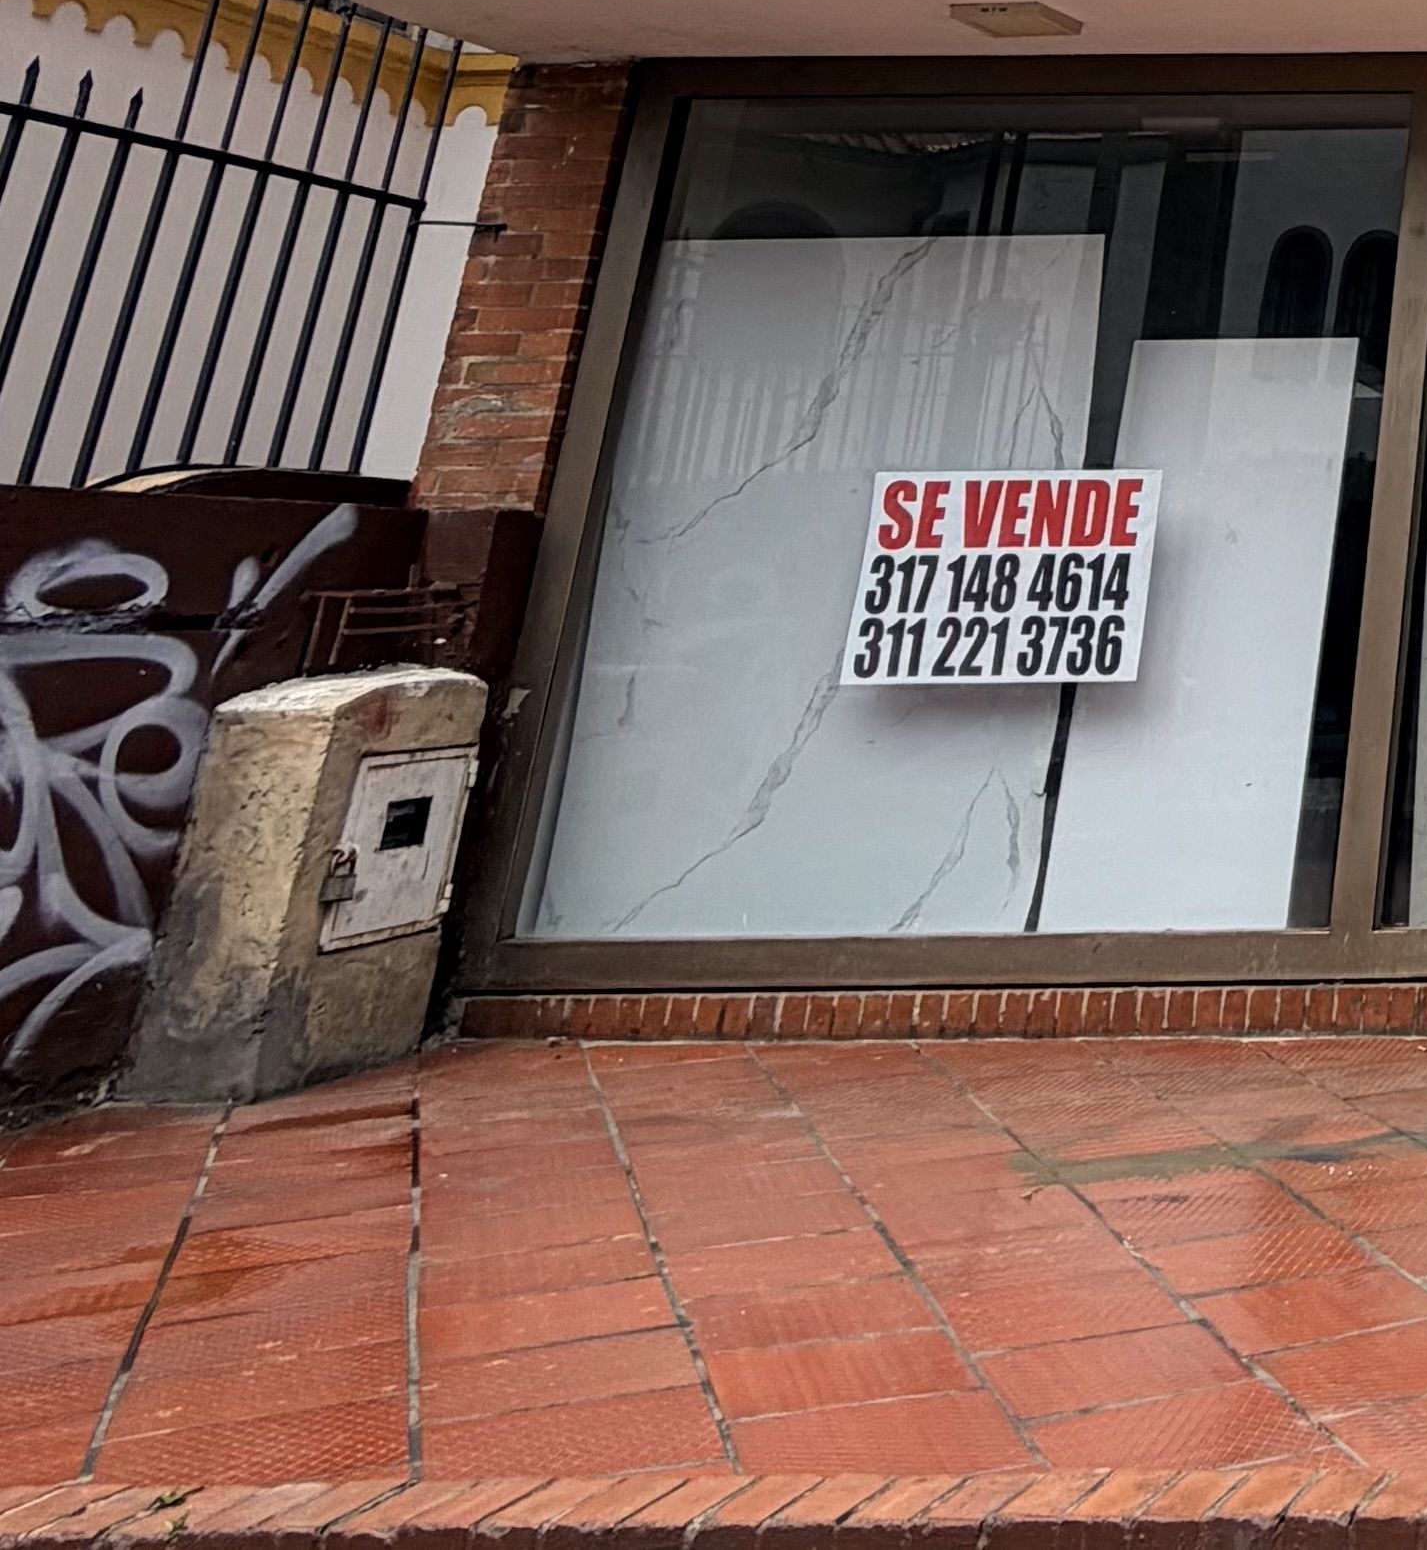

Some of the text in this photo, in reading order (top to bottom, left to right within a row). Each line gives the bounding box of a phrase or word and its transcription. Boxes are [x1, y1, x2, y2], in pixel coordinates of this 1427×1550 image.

[878, 478, 1144, 549] SE VENDE
[864, 553, 1131, 614] 317 148 4614
[853, 615, 1125, 678] 311 221 3736
